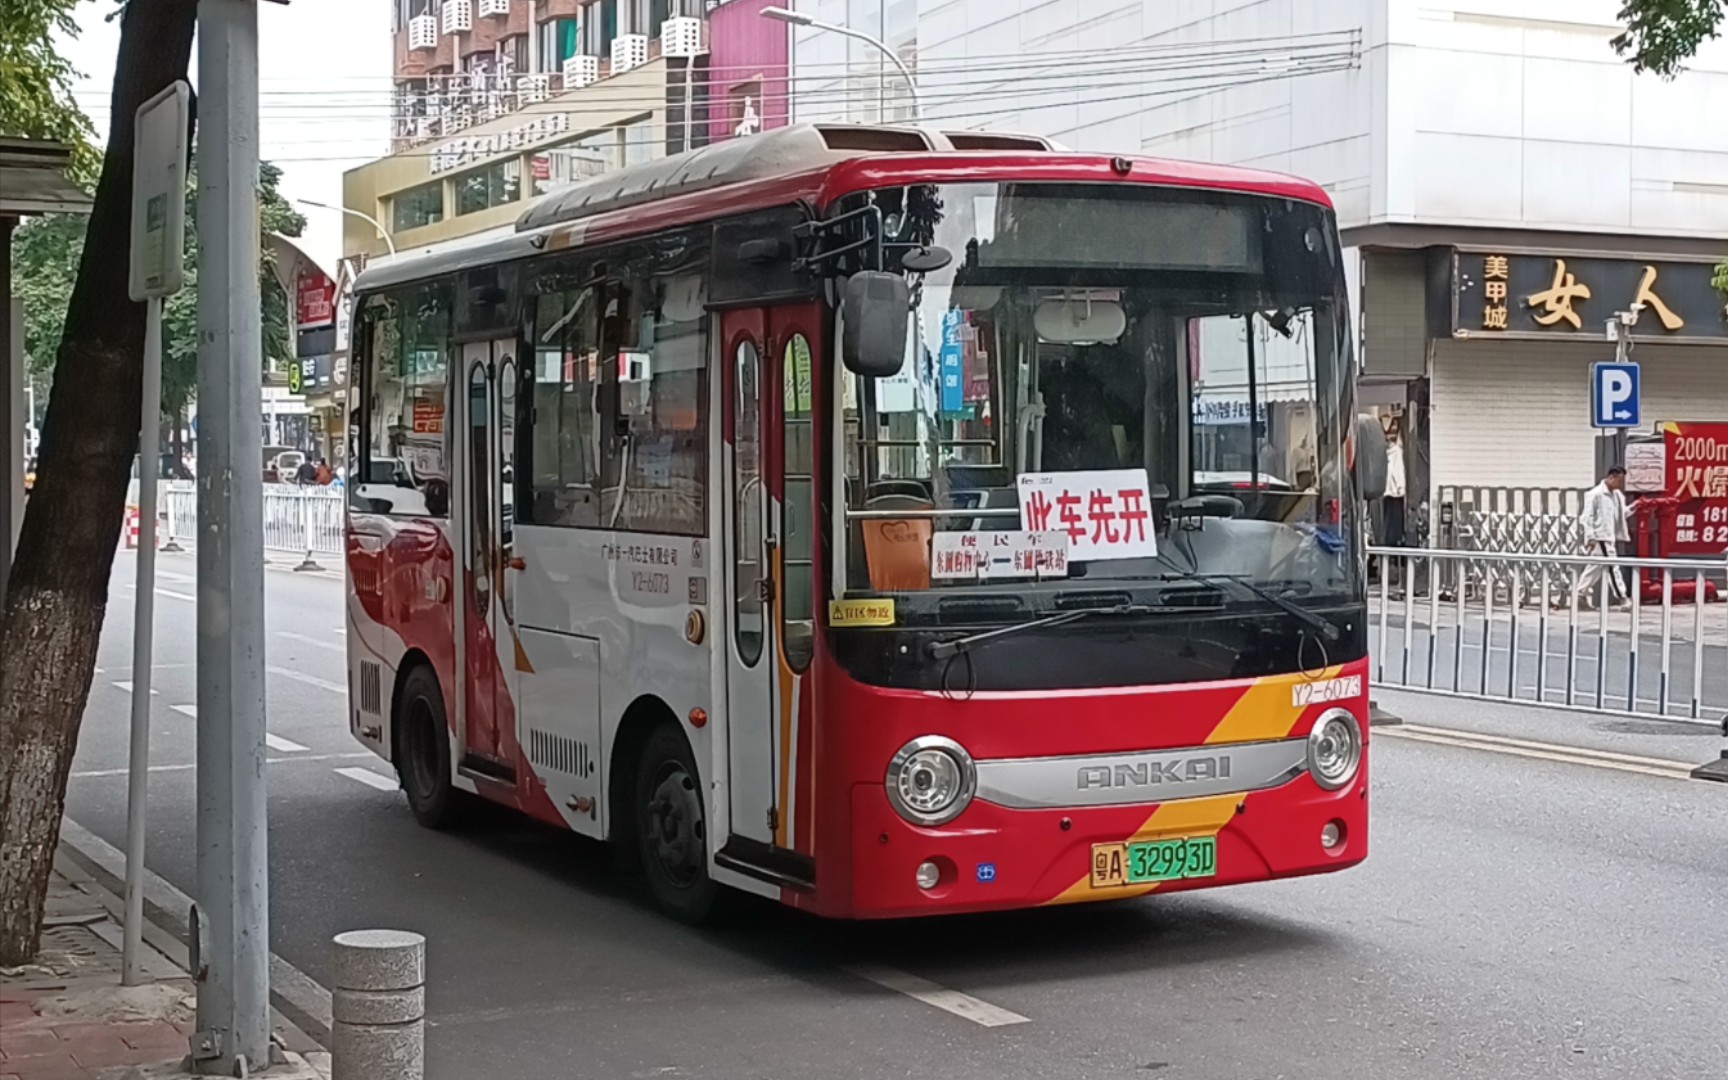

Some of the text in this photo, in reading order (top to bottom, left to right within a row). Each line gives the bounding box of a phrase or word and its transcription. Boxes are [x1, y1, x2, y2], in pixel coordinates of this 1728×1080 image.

[1483, 255, 1508, 330] 美甲城
[1527, 258, 1684, 330] 女人
[1602, 369, 1632, 421] P
[1025, 488, 1148, 546] 此车先开
[1293, 676, 1361, 706] Y2-6073
[1077, 755, 1231, 790] ANKAI
[1133, 841, 1214, 878] 32993D
